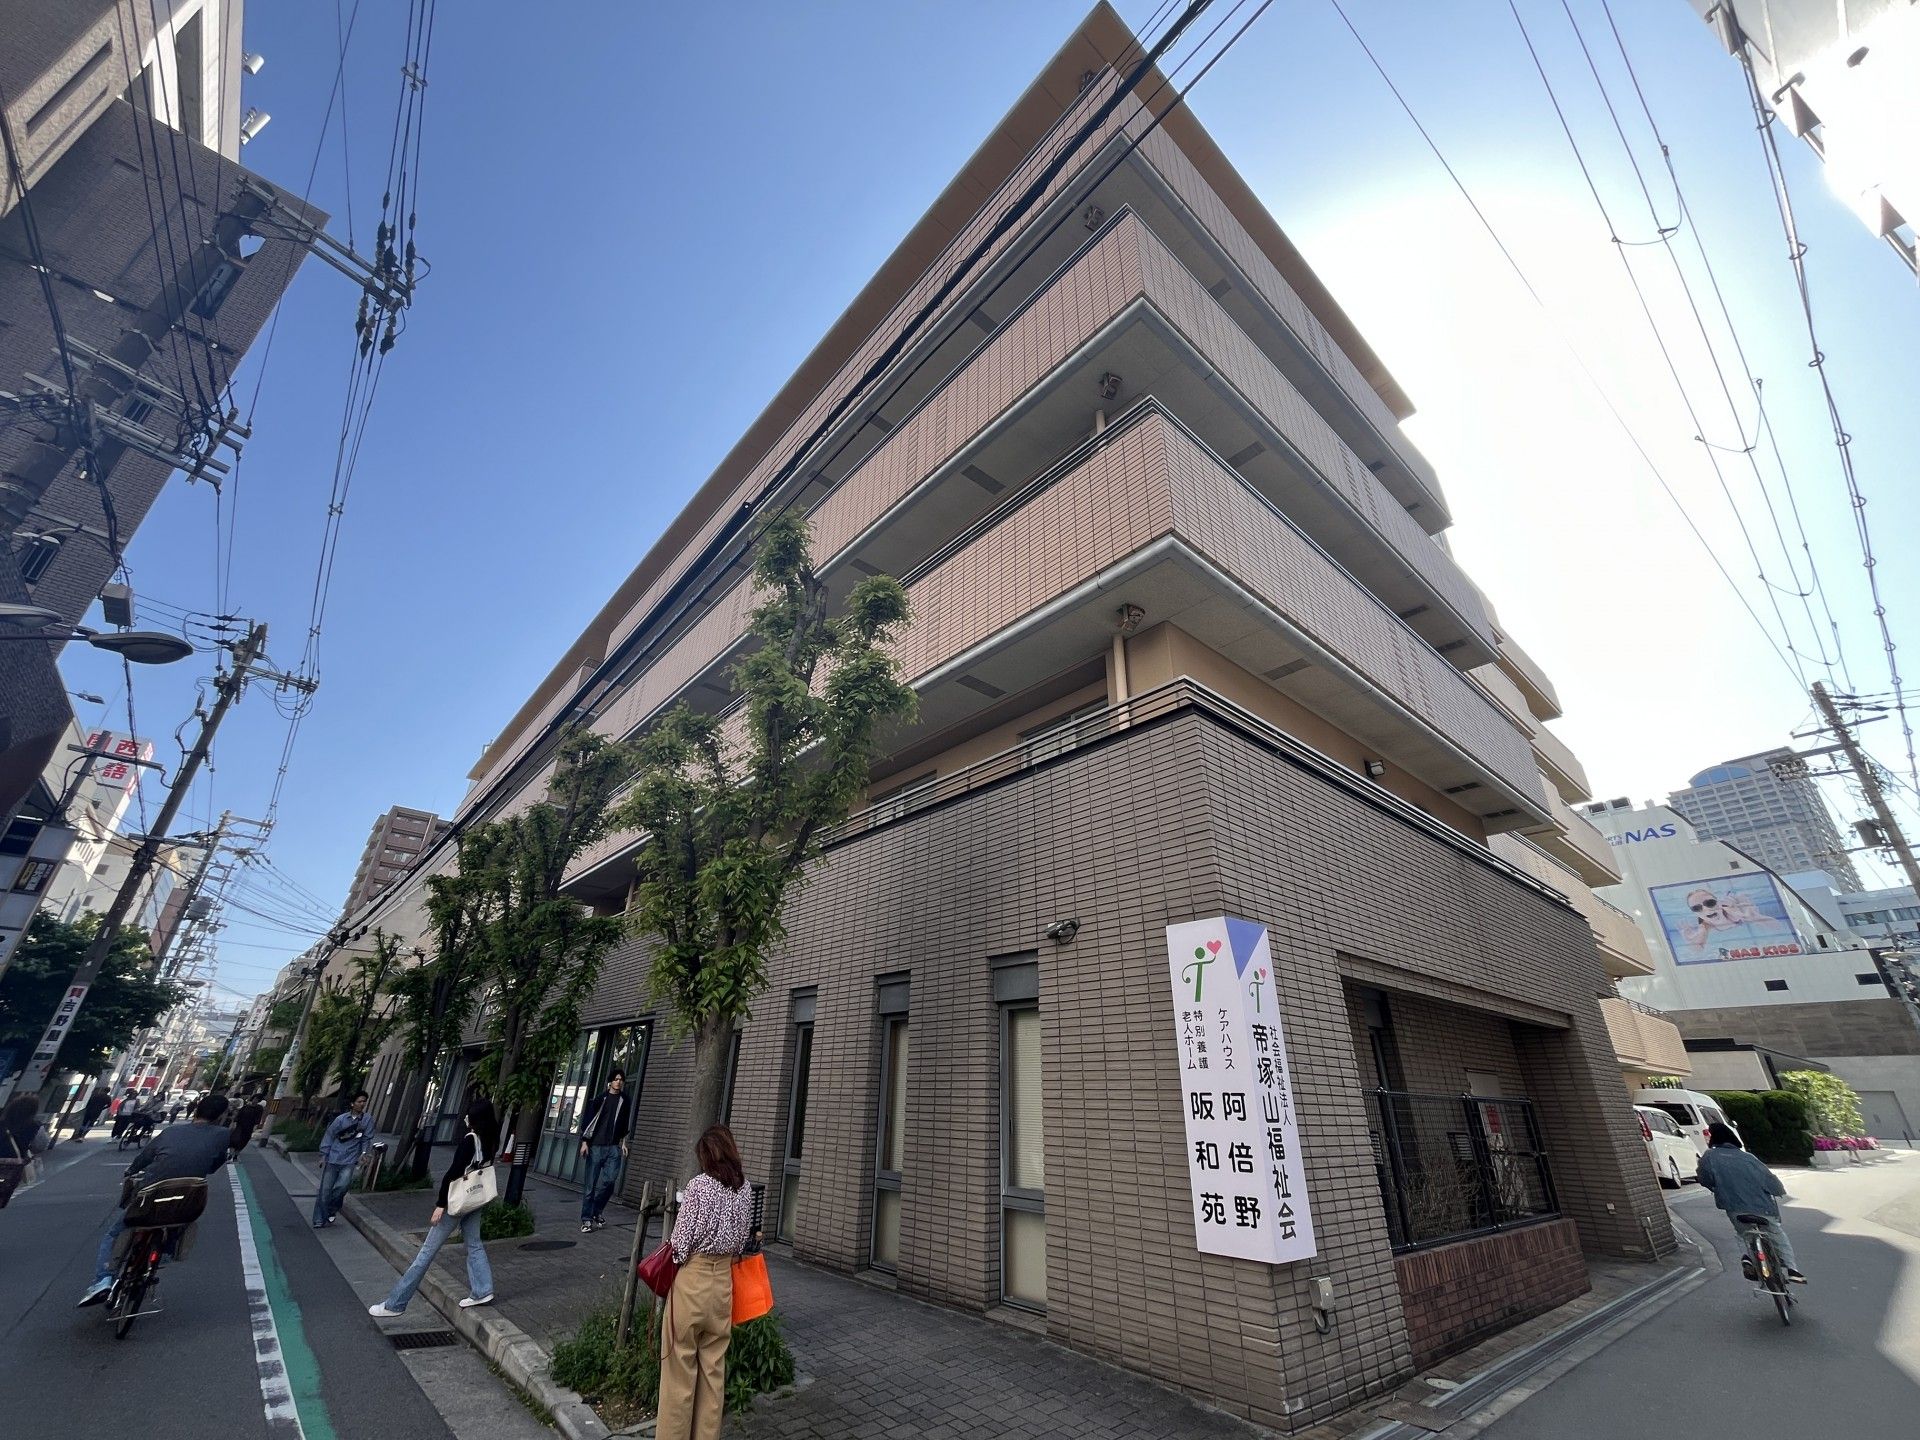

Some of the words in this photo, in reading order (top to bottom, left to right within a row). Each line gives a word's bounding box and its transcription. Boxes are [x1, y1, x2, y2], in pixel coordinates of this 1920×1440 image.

[1625, 823, 1677, 844] NAS
[1181, 1011, 1198, 1070] 老人ホーム
[1193, 1010, 1210, 1070] 特別養護
[1218, 1007, 1236, 1070] ケアハウス
[1269, 1025, 1292, 1126] 社会福祉法人
[1190, 1092, 1227, 1225] 阪和苑
[1222, 1092, 1261, 1229] 阿倍野
[1252, 1023, 1297, 1240] 帝塚山福祉会
